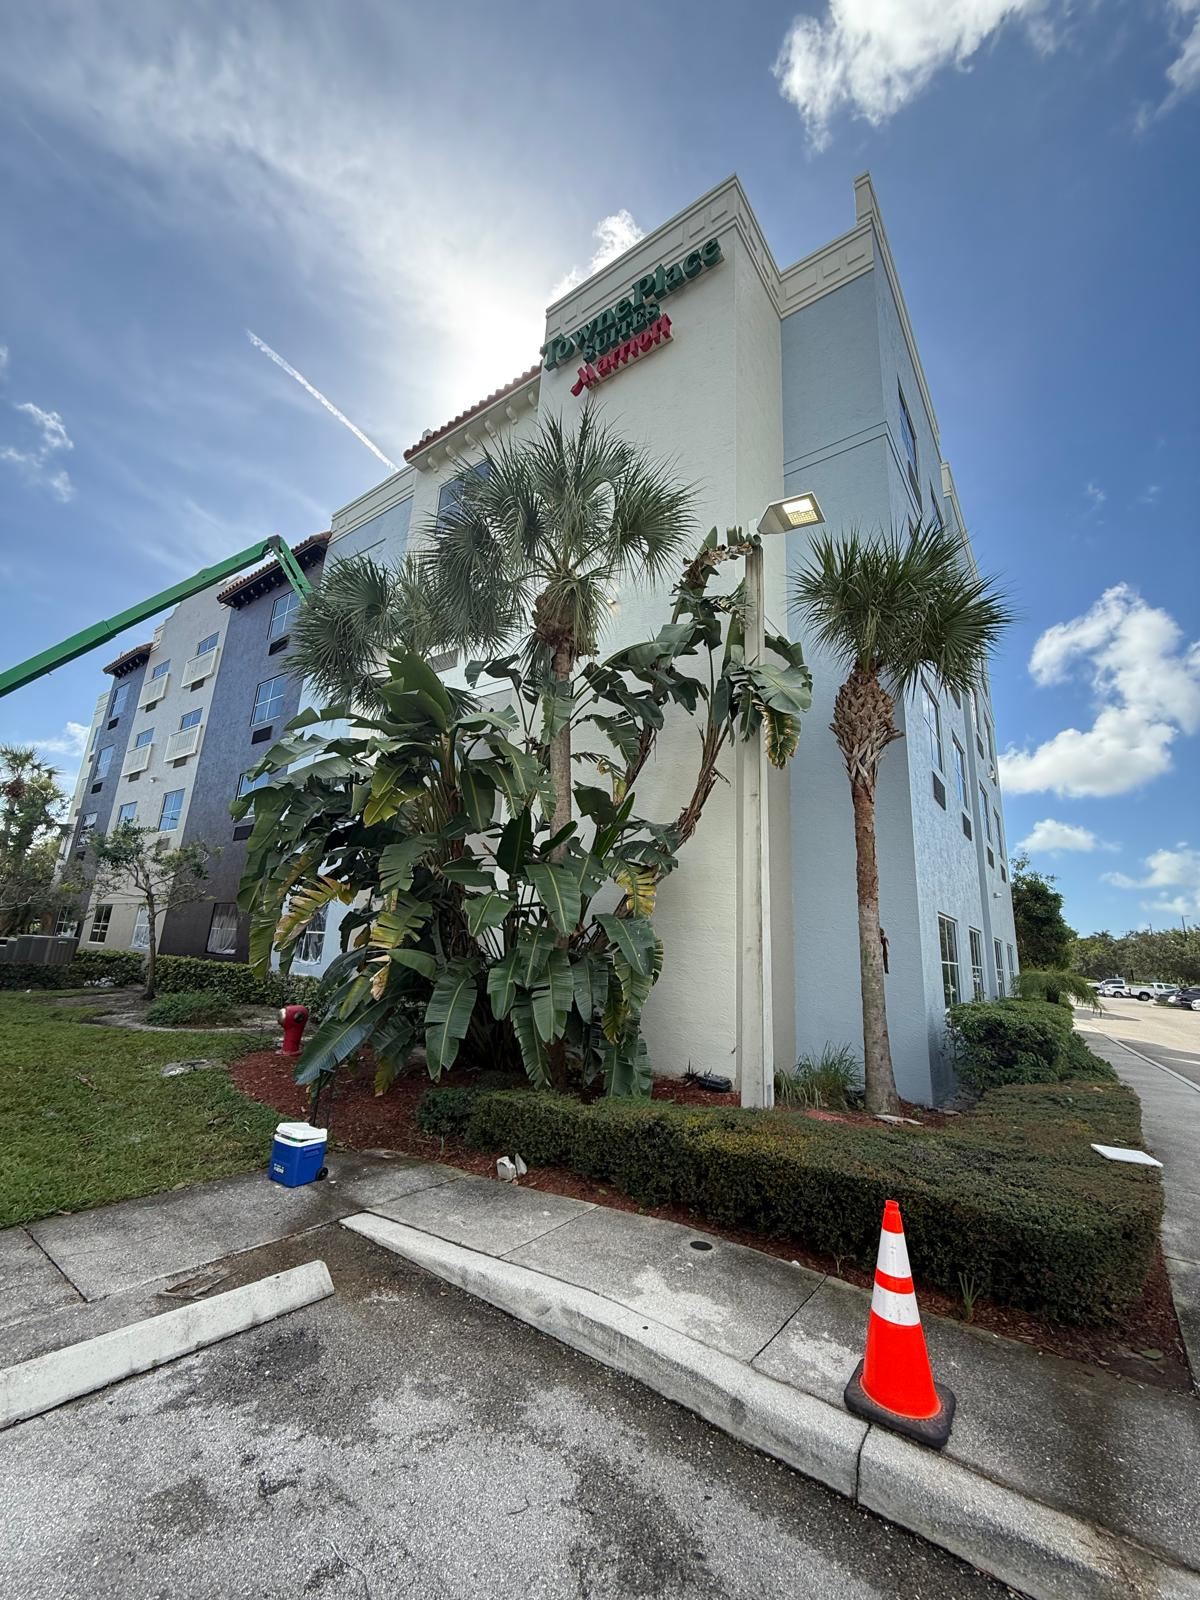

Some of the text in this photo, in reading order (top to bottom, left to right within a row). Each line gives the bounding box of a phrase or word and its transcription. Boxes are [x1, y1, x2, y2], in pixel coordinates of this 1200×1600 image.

[540, 237, 724, 371] TownePlace
[583, 303, 661, 364] SUITES
[570, 313, 672, 397] Marriott
